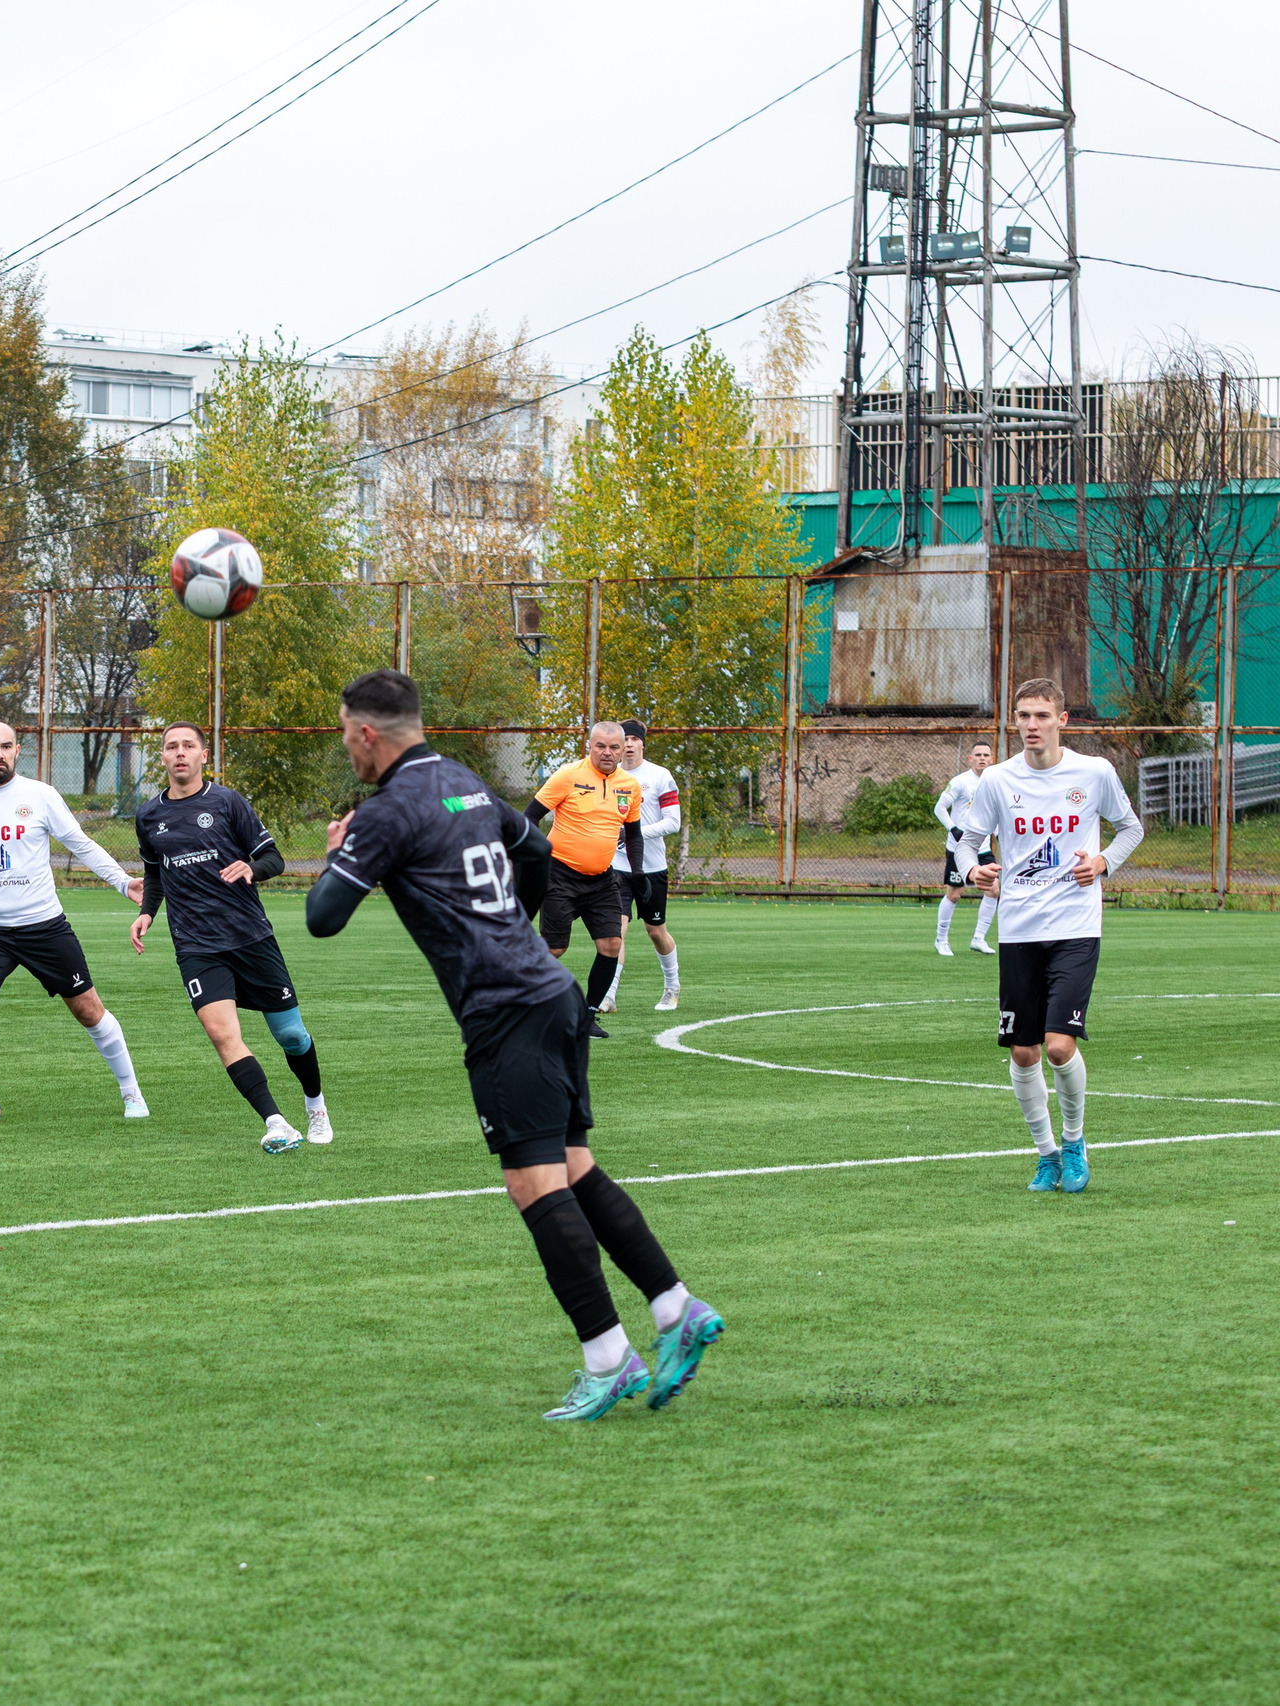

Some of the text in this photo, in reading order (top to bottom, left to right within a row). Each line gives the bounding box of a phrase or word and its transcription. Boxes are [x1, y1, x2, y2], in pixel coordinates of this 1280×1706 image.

[1014, 815, 1080, 835] СССР
[172, 852, 219, 868] TATNEFT
[462, 841, 517, 914] 92
[949, 871, 962, 883] 26
[184, 978, 203, 1003] 0
